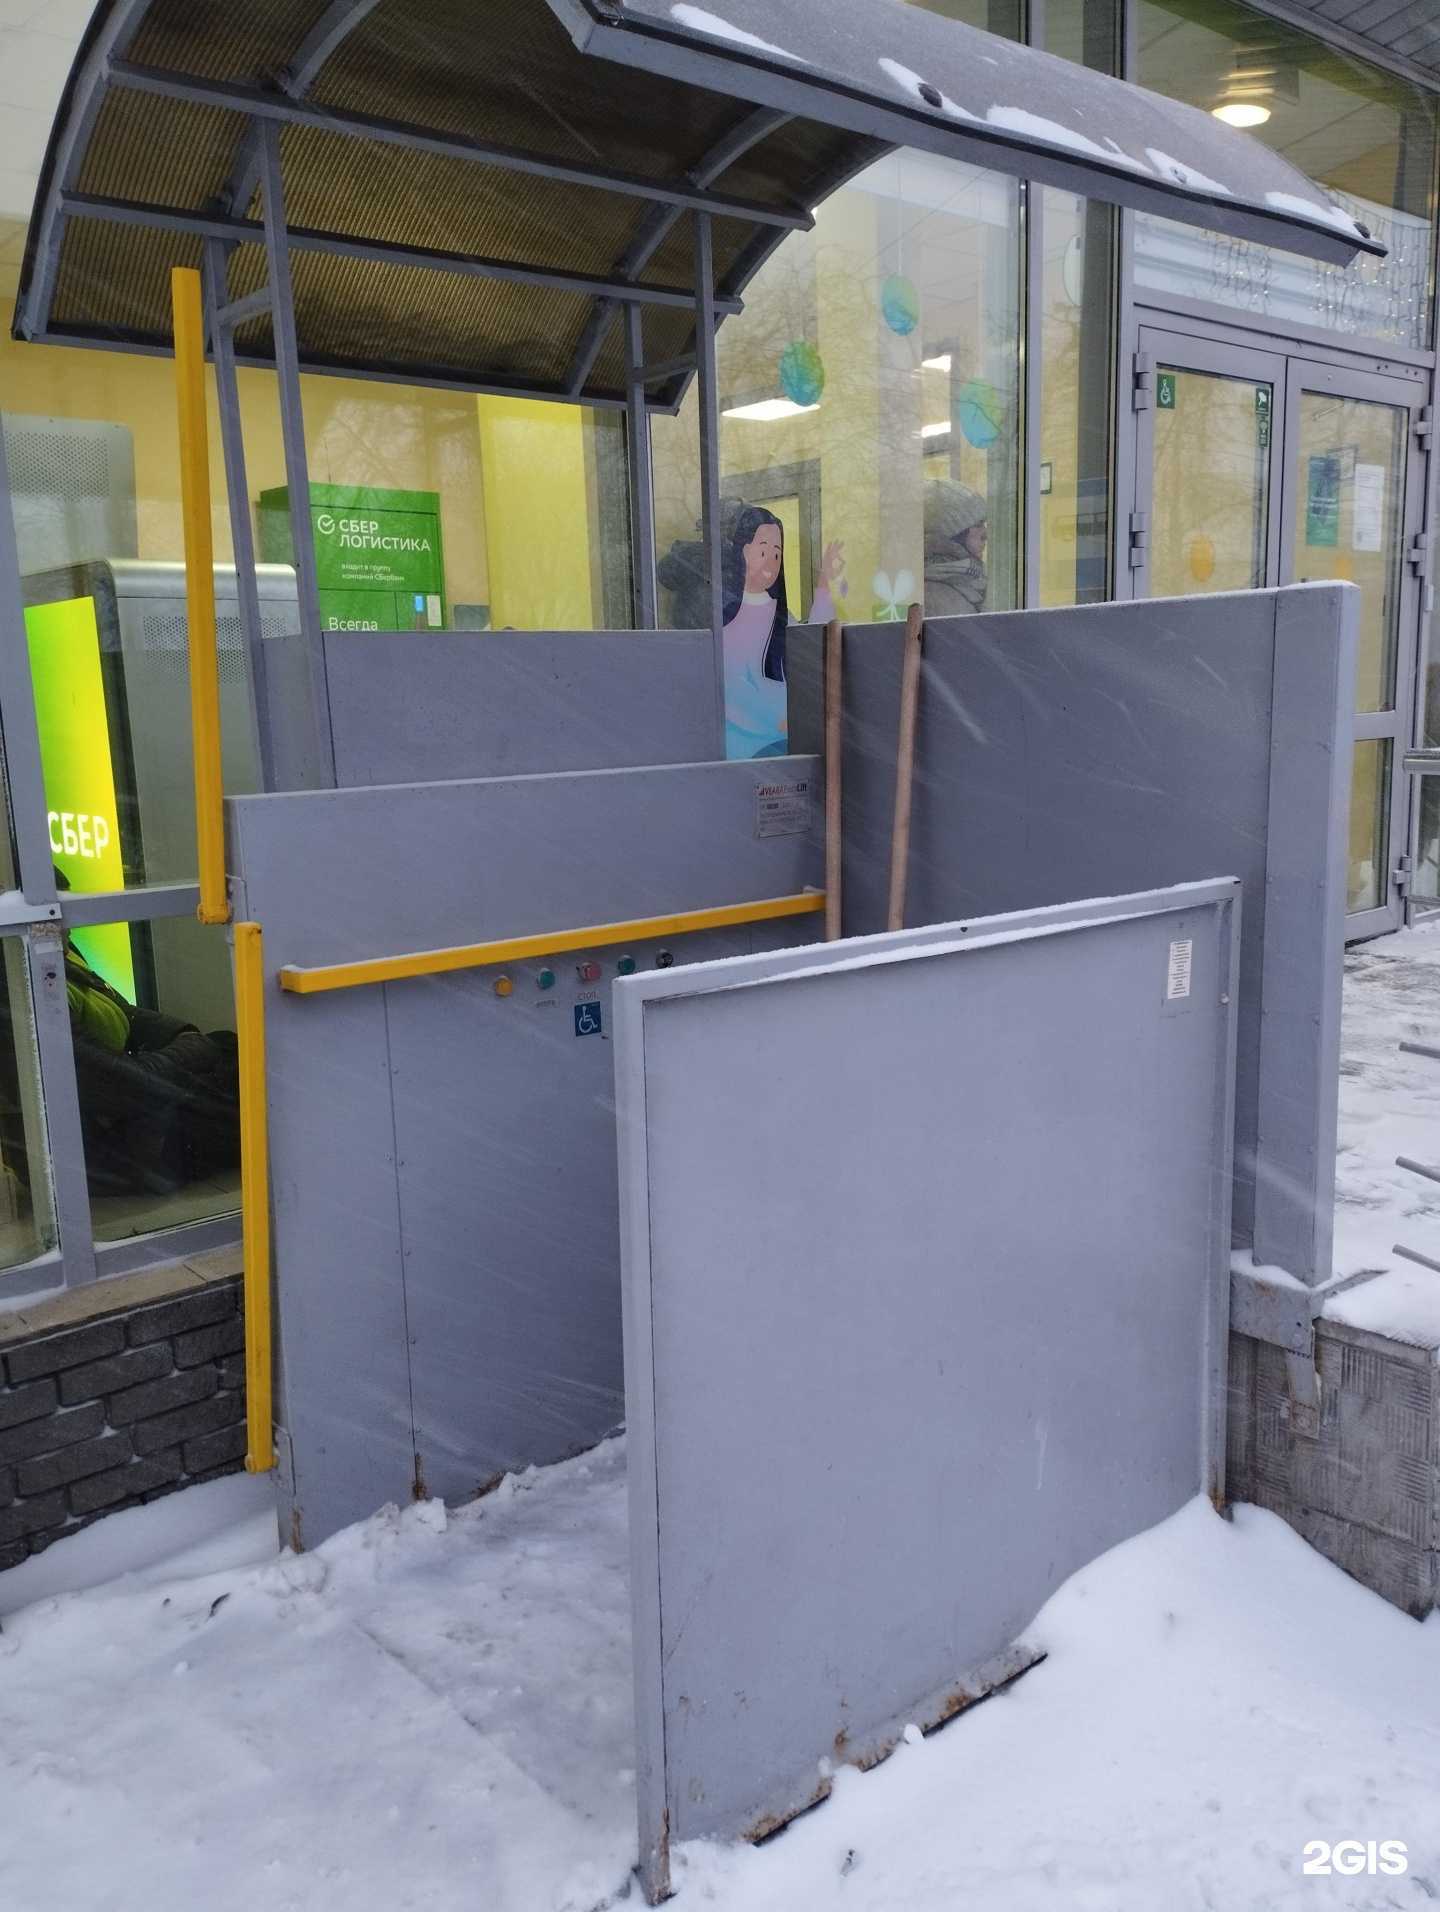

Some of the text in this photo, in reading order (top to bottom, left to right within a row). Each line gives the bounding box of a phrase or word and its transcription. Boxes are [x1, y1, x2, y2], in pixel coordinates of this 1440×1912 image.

[339, 519, 378, 534] СБЕР
[339, 534, 431, 552] ЛОГИСТИКА
[328, 617, 378, 631] Всегда
[48, 812, 109, 858] СБЕР
